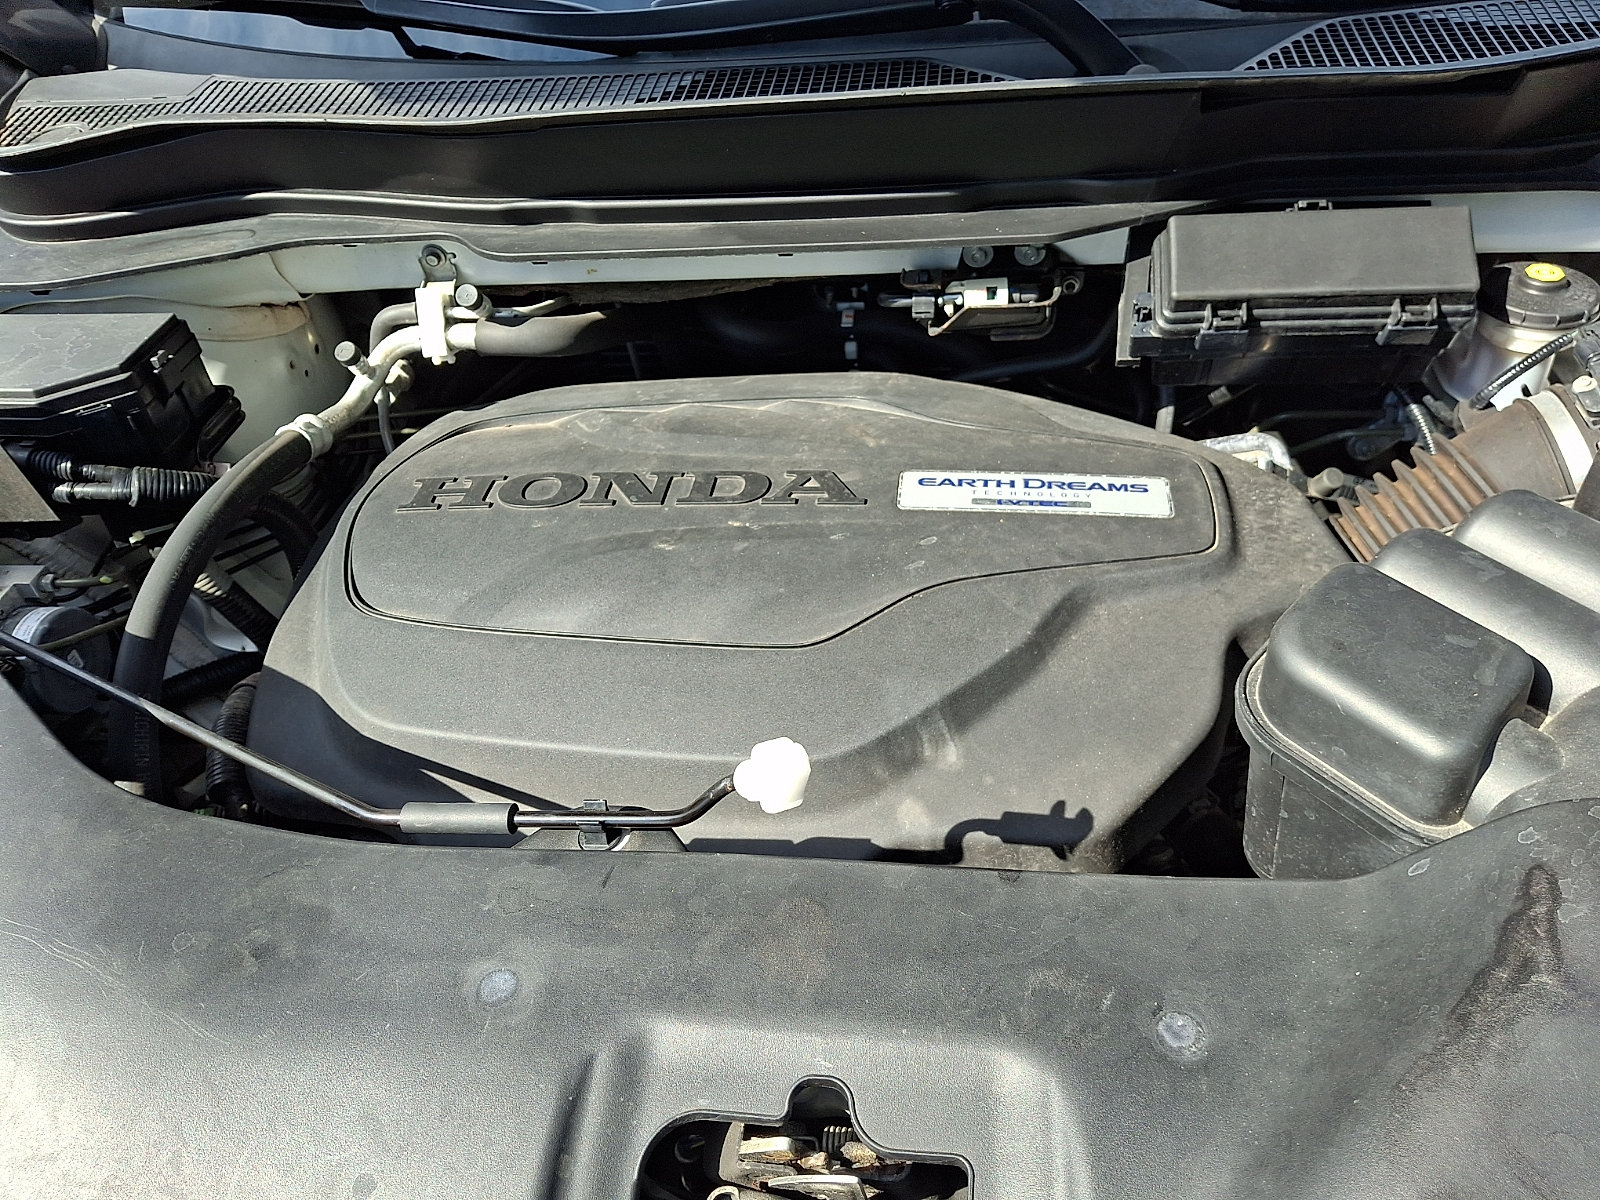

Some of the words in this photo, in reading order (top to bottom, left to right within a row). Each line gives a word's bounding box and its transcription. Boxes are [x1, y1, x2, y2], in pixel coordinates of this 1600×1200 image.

[397, 470, 868, 513] HONDA
[918, 477, 1015, 489] EARTH
[1023, 478, 1149, 493] DREAMS
[972, 489, 1092, 499] TECHNOLOGY
